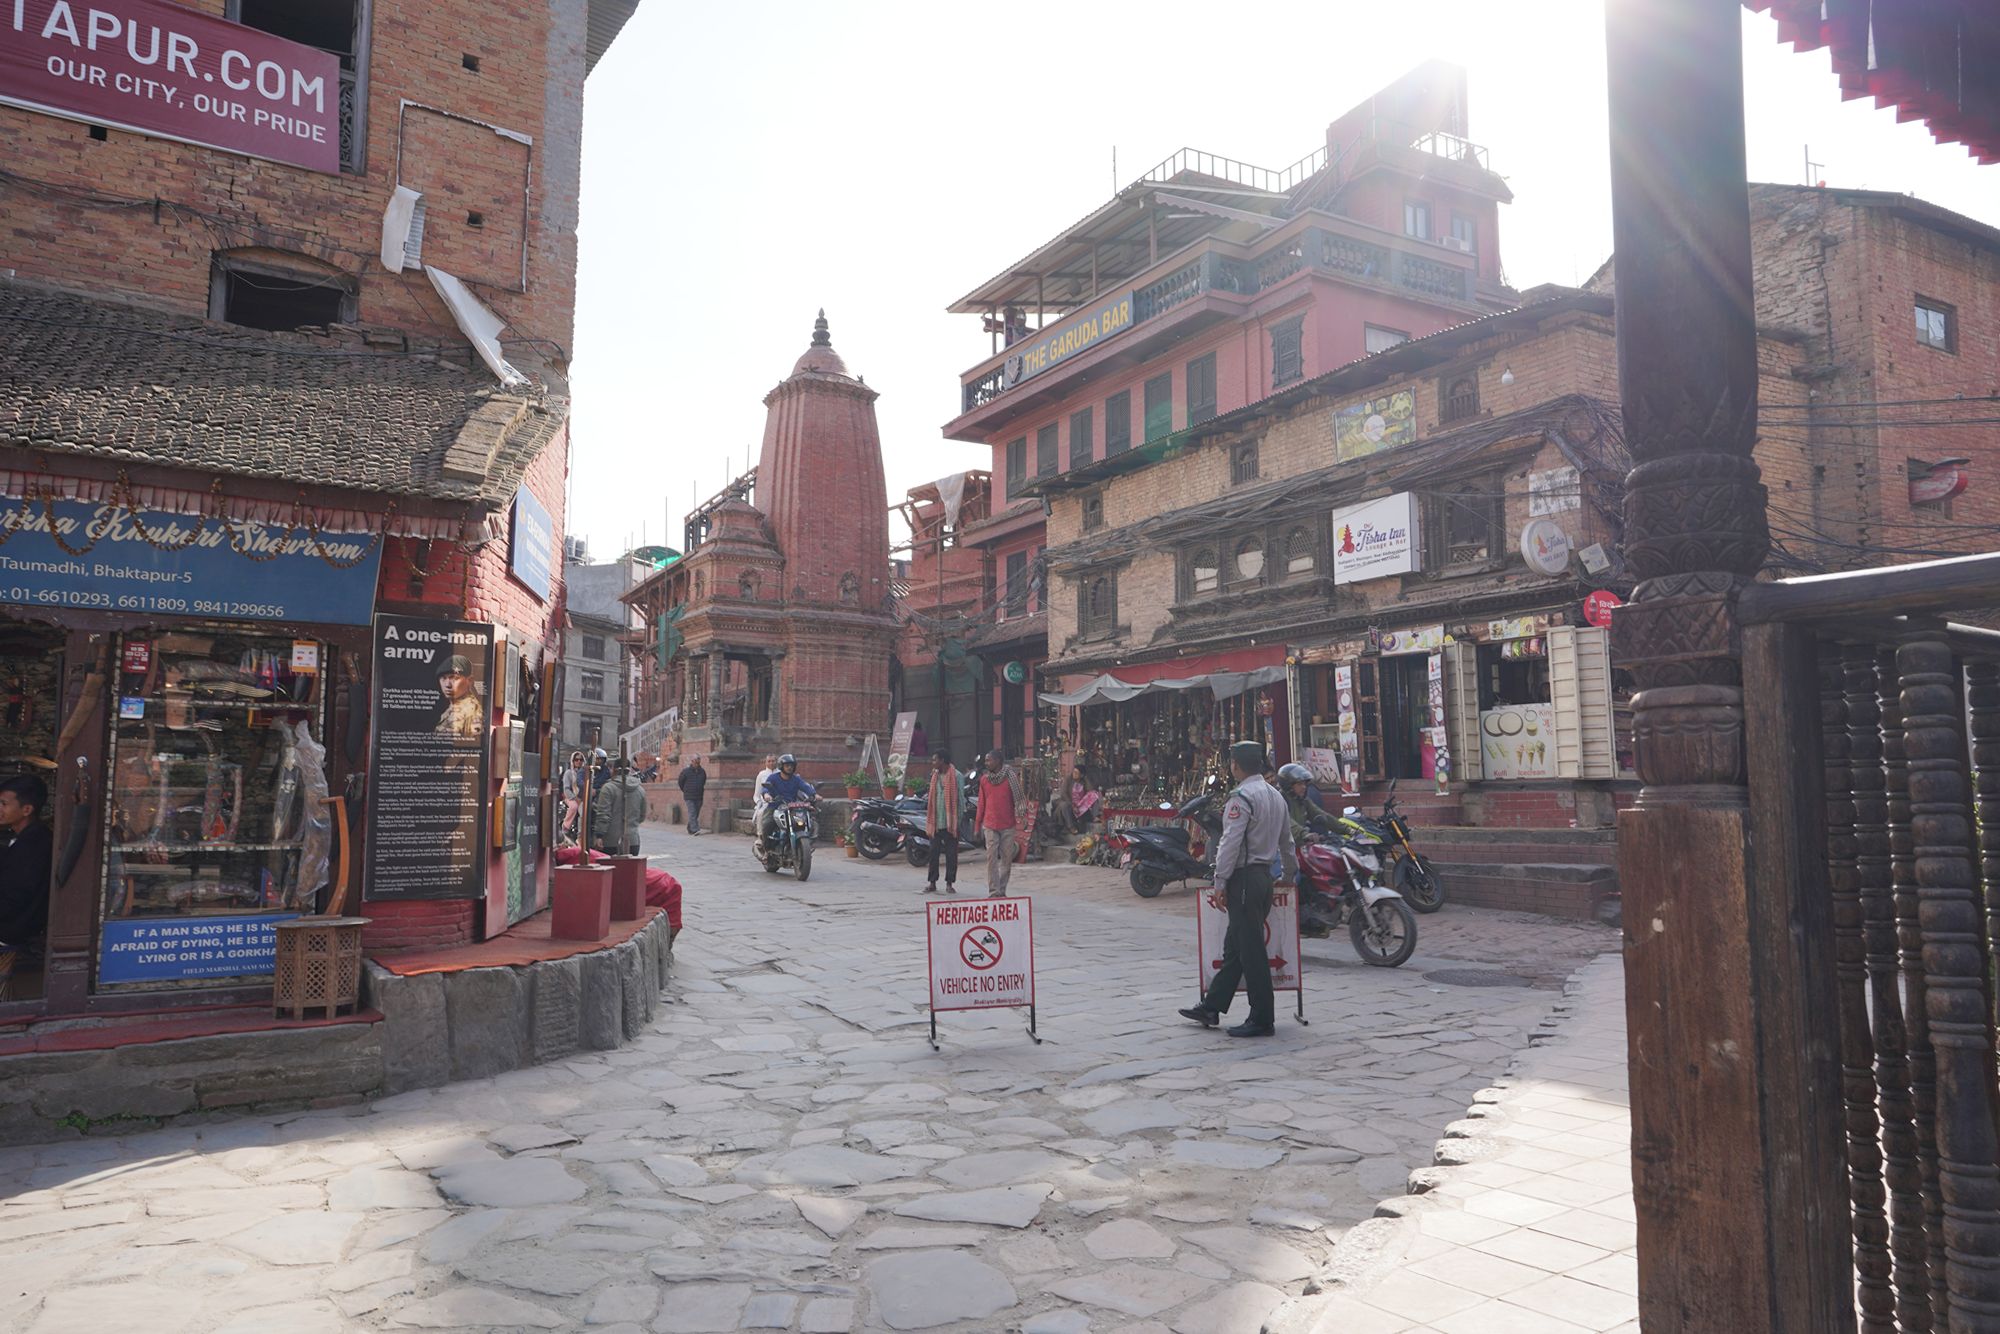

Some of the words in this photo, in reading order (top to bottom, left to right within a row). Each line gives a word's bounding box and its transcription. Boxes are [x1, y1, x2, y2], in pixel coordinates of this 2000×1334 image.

[47, 55, 107, 87] OUR
[115, 73, 185, 109] CITY,
[193, 94, 246, 123] OUR
[253, 108, 326, 143] PRIDE
[1024, 345, 1046, 375] THE
[1049, 319, 1098, 361] GARUDA
[1102, 301, 1129, 334] BAR
[229, 522, 364, 560] Showroom
[1389, 528, 1406, 540] Inn
[0, 556, 89, 577] Taumadhi,
[94, 564, 192, 584] Bhaktapur-5
[11, 587, 114, 608] 01-6610293,
[118, 595, 190, 613] 6611809,
[193, 600, 285, 618] 9841299656
[384, 625, 399, 640] A
[405, 629, 488, 645] one-man
[384, 646, 435, 663] army
[936, 905, 989, 925] HERITAGE
[992, 903, 1019, 922] AREA
[133, 929, 145, 938] IF
[149, 928, 158, 937] A
[161, 927, 189, 936] MAN
[193, 925, 223, 935] SAYS
[227, 924, 243, 933] HE
[247, 923, 258, 932] IS
[111, 942, 158, 952] AFRAID
[162, 941, 178, 950] OF
[182, 939, 224, 949] DYING,
[227, 937, 243, 946] HE
[247, 936, 258, 945] IS
[138, 954, 176, 963] LYING
[180, 952, 198, 961] OR
[201, 951, 213, 960] IS
[216, 950, 225, 959] A
[940, 977, 978, 994] VEHICLE
[980, 976, 995, 992] NO
[998, 974, 1025, 991] ENTRY
